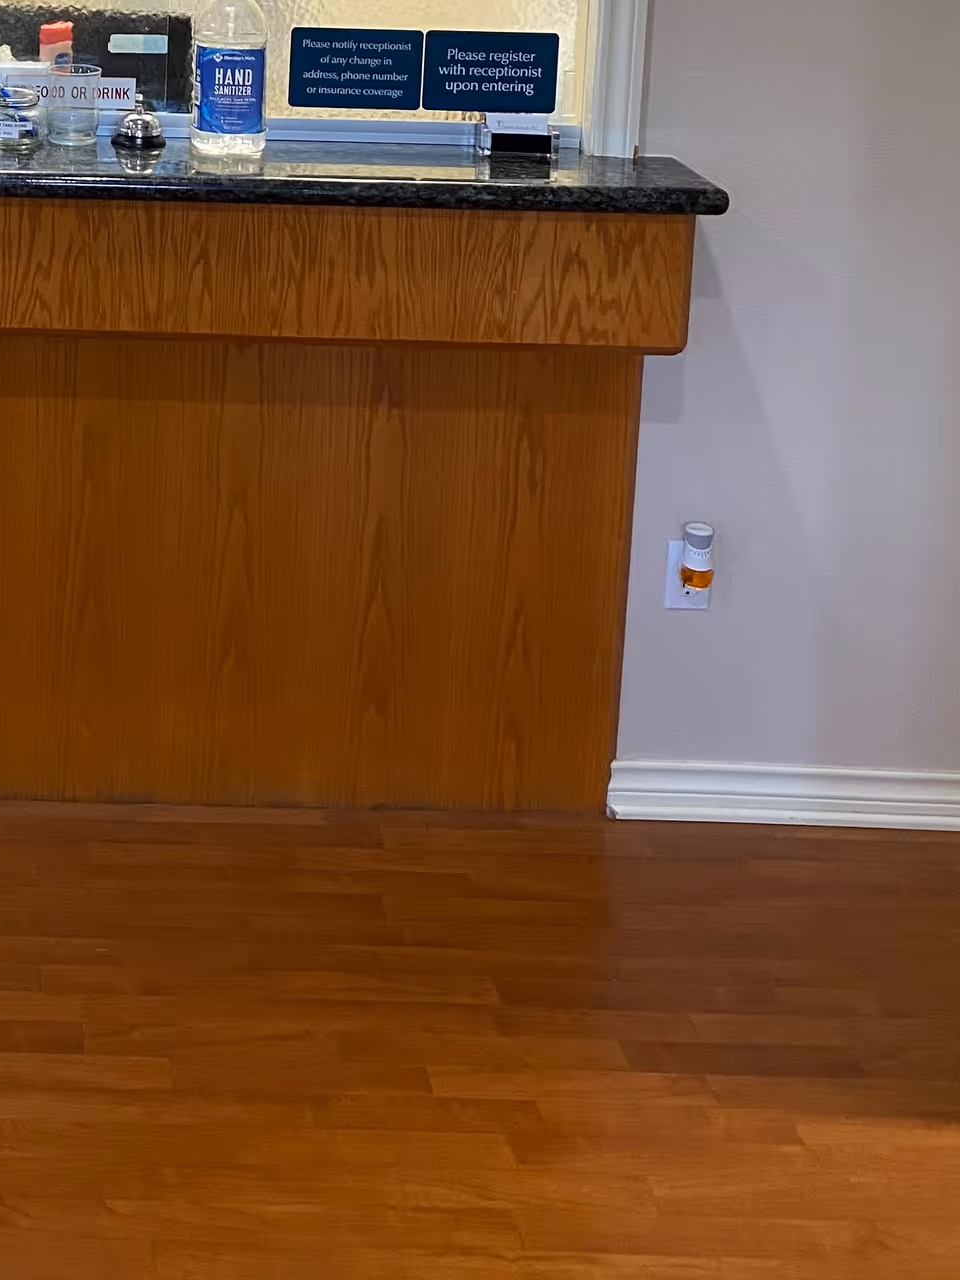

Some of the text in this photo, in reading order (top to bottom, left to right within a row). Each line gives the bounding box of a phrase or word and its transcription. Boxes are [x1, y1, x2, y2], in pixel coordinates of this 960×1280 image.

[303, 39, 411, 52] Please notify receptionist
[320, 55, 392, 67] of any change in
[447, 48, 536, 65] Please register
[215, 68, 252, 85] HAND
[303, 70, 408, 81] address, phone number
[439, 64, 542, 79] with receptionist
[72, 86, 86, 99] OR
[93, 87, 130, 100] DRINK
[214, 85, 251, 96] SANITIZER
[319, 86, 361, 95] insurance
[363, 88, 403, 98] coverage
[445, 81, 534, 96] upon entering
